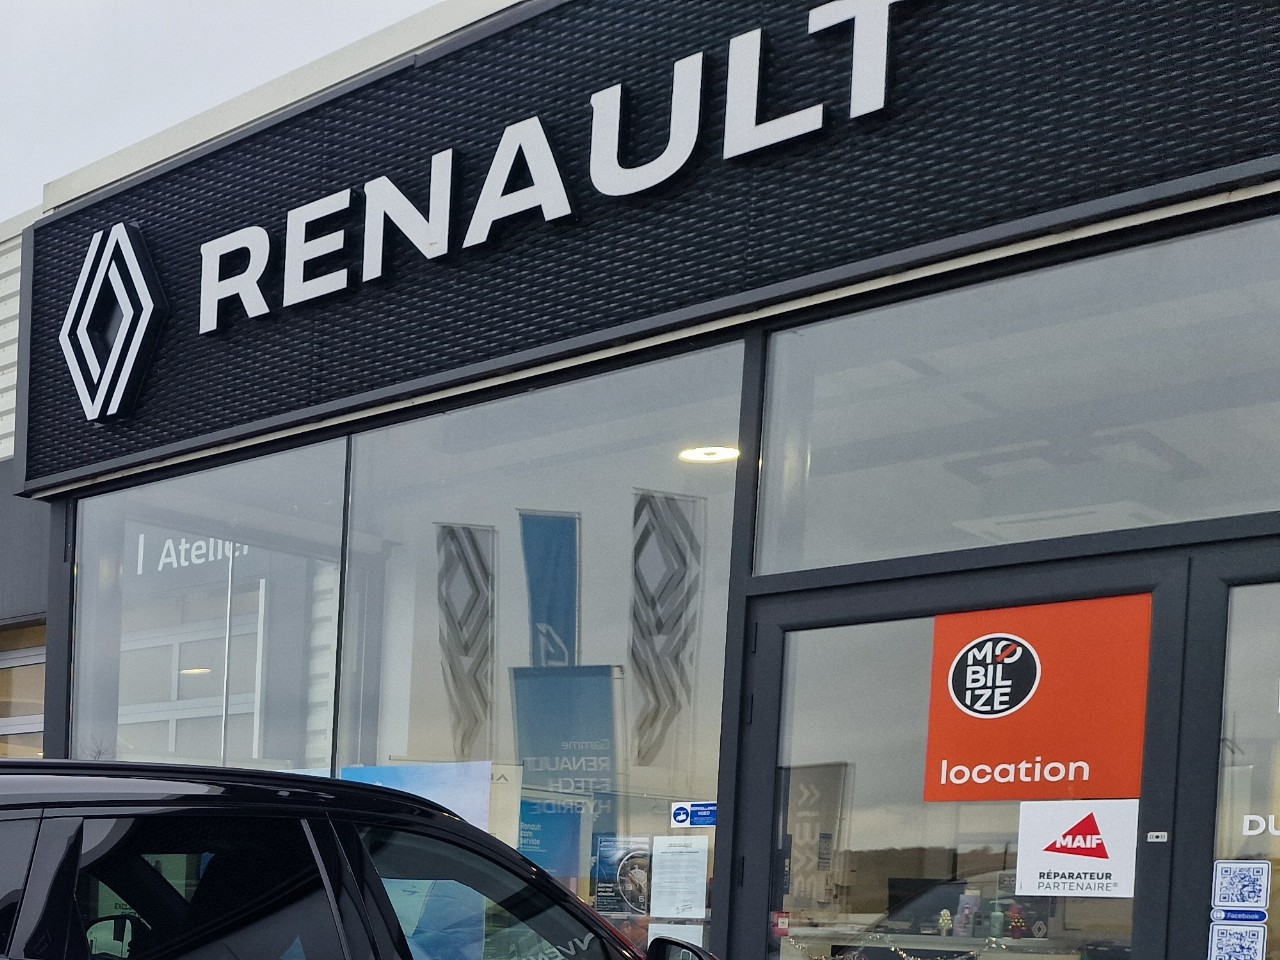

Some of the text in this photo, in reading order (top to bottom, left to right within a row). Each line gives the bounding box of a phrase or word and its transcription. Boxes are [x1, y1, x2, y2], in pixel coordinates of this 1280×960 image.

[199, 0, 900, 334] RENAULT
[940, 755, 1090, 785] location
[1055, 834, 1103, 849] MAIF
[1038, 869, 1112, 880] RÉPARATEUR
